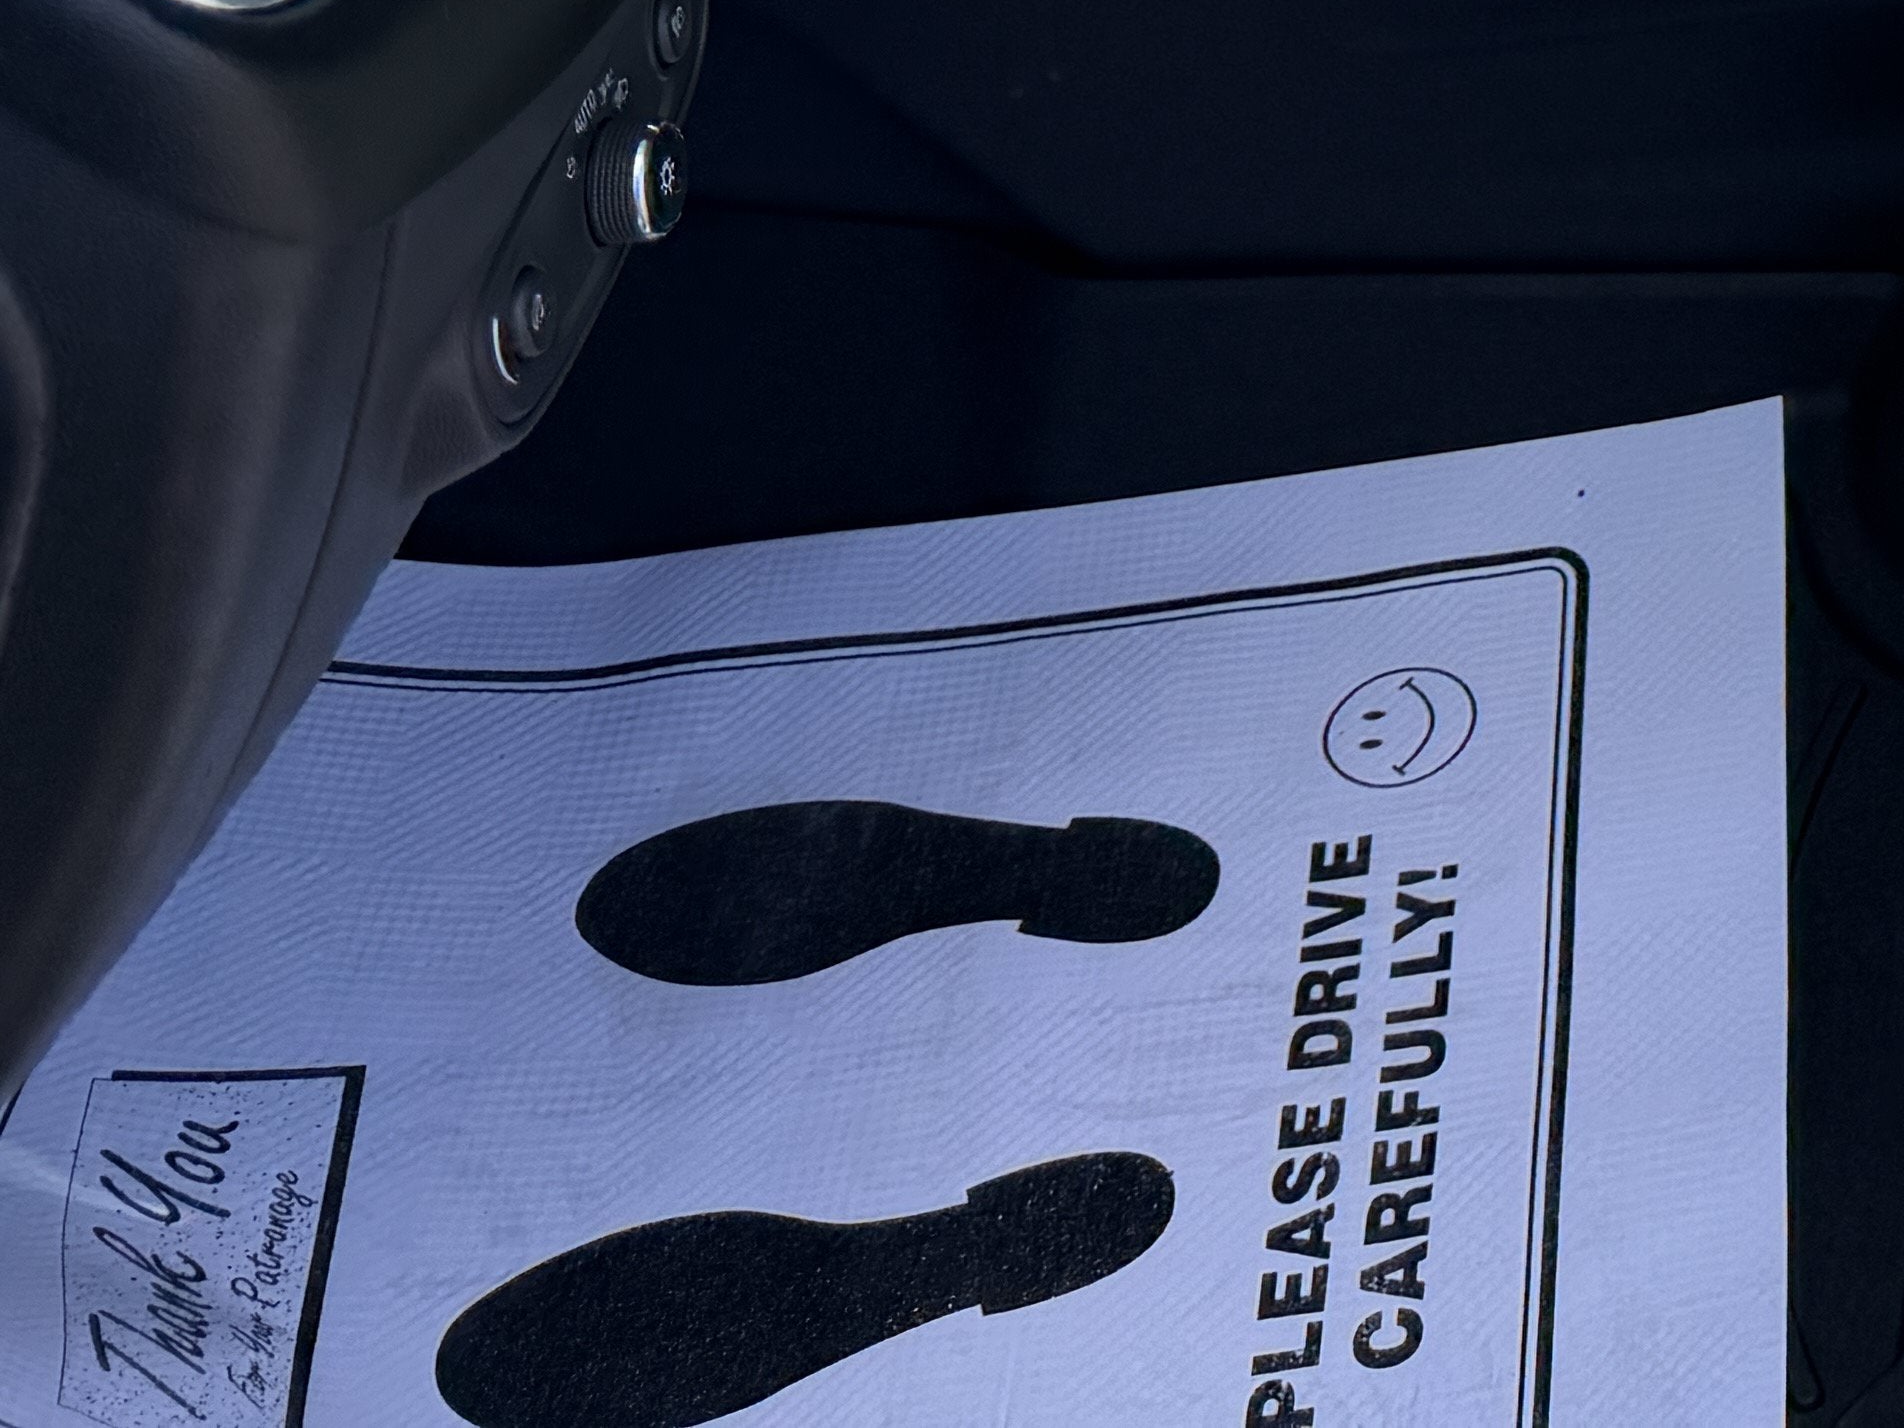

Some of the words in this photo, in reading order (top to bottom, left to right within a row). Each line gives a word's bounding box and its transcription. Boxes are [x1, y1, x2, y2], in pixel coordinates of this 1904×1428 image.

[1287, 834, 1373, 1071] DRIVE
[1353, 863, 1460, 1370] CAREFULLY!
[88, 1225, 213, 1421] Thank
[228, 1312, 276, 1359] Your
[230, 1169, 320, 1309] Patronage
[1245, 1097, 1347, 1428] PLEASE
[226, 1362, 269, 1409] For
